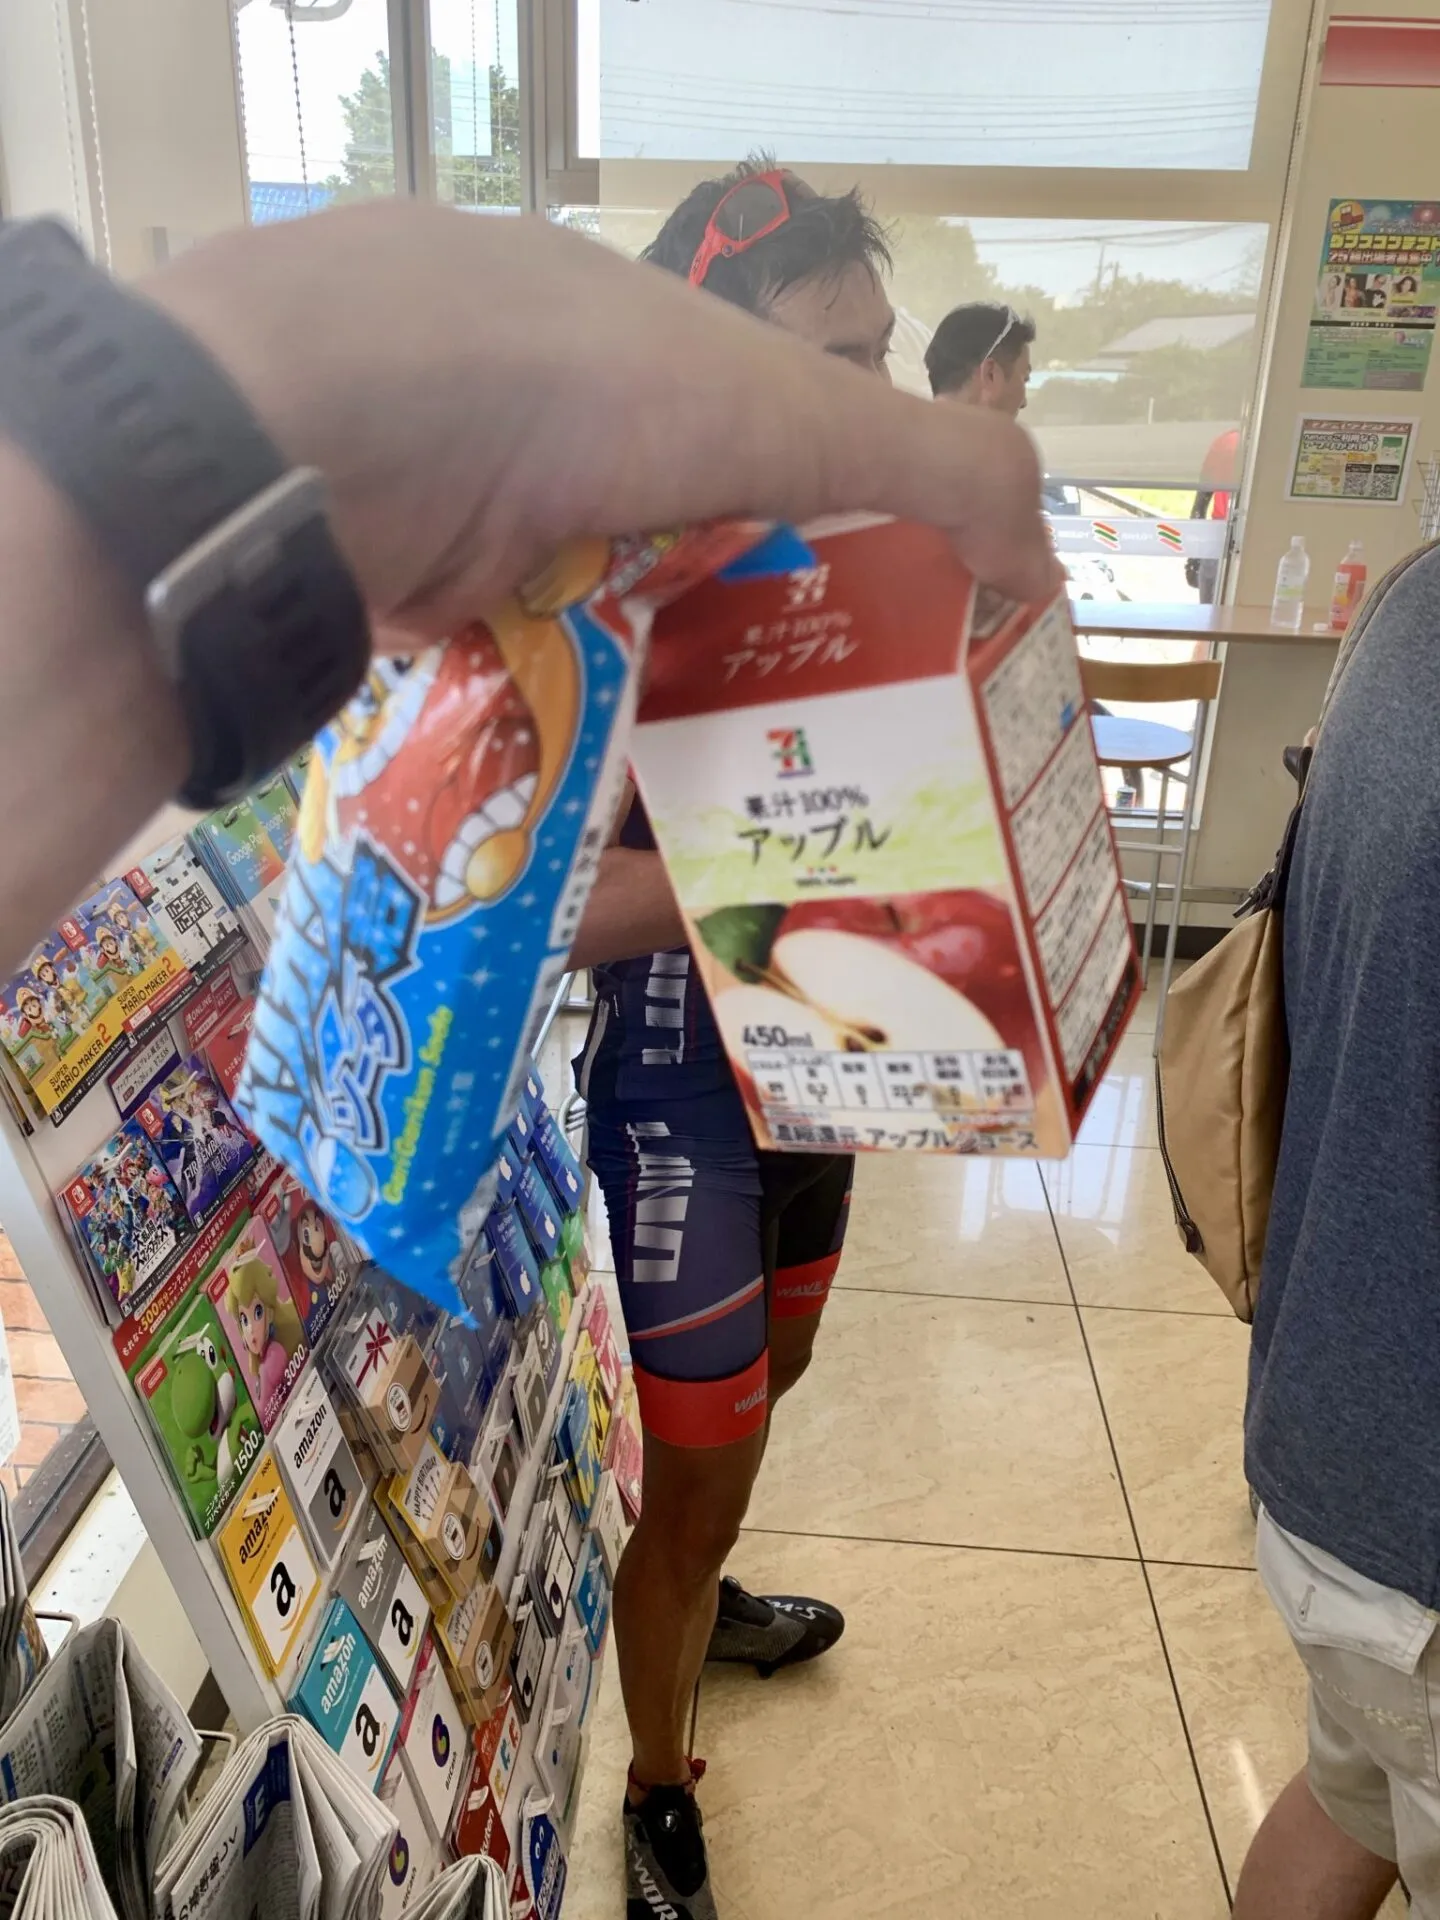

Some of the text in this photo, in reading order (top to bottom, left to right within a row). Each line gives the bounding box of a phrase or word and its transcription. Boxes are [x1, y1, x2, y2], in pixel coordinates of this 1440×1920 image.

[736, 814, 892, 867] アップル
[117, 986, 137, 1004] SUPER
[121, 991, 147, 1017] MARIO
[144, 971, 170, 997] MAKER
[162, 956, 177, 975] 2
[54, 1067, 81, 1098] MARIO
[77, 1041, 104, 1071] MAKER
[97, 1022, 112, 1045] 2
[742, 1024, 814, 1049] 450ml
[50, 1064, 70, 1089] SUPER
[327, 1269, 347, 1307] 5000
[285, 1343, 306, 1387] 3000
[233, 1428, 260, 1477] 1500
[293, 1403, 327, 1470] amazon
[204, 1478, 230, 1518] ニンテンドー
[324, 1467, 346, 1518] a
[412, 1455, 440, 1519] HAPPY BIRTHDAY
[271, 1562, 296, 1617] a
[358, 1536, 388, 1610] amazon
[391, 1598, 414, 1647] a
[320, 1631, 357, 1716] amazon
[355, 1702, 381, 1758] a
